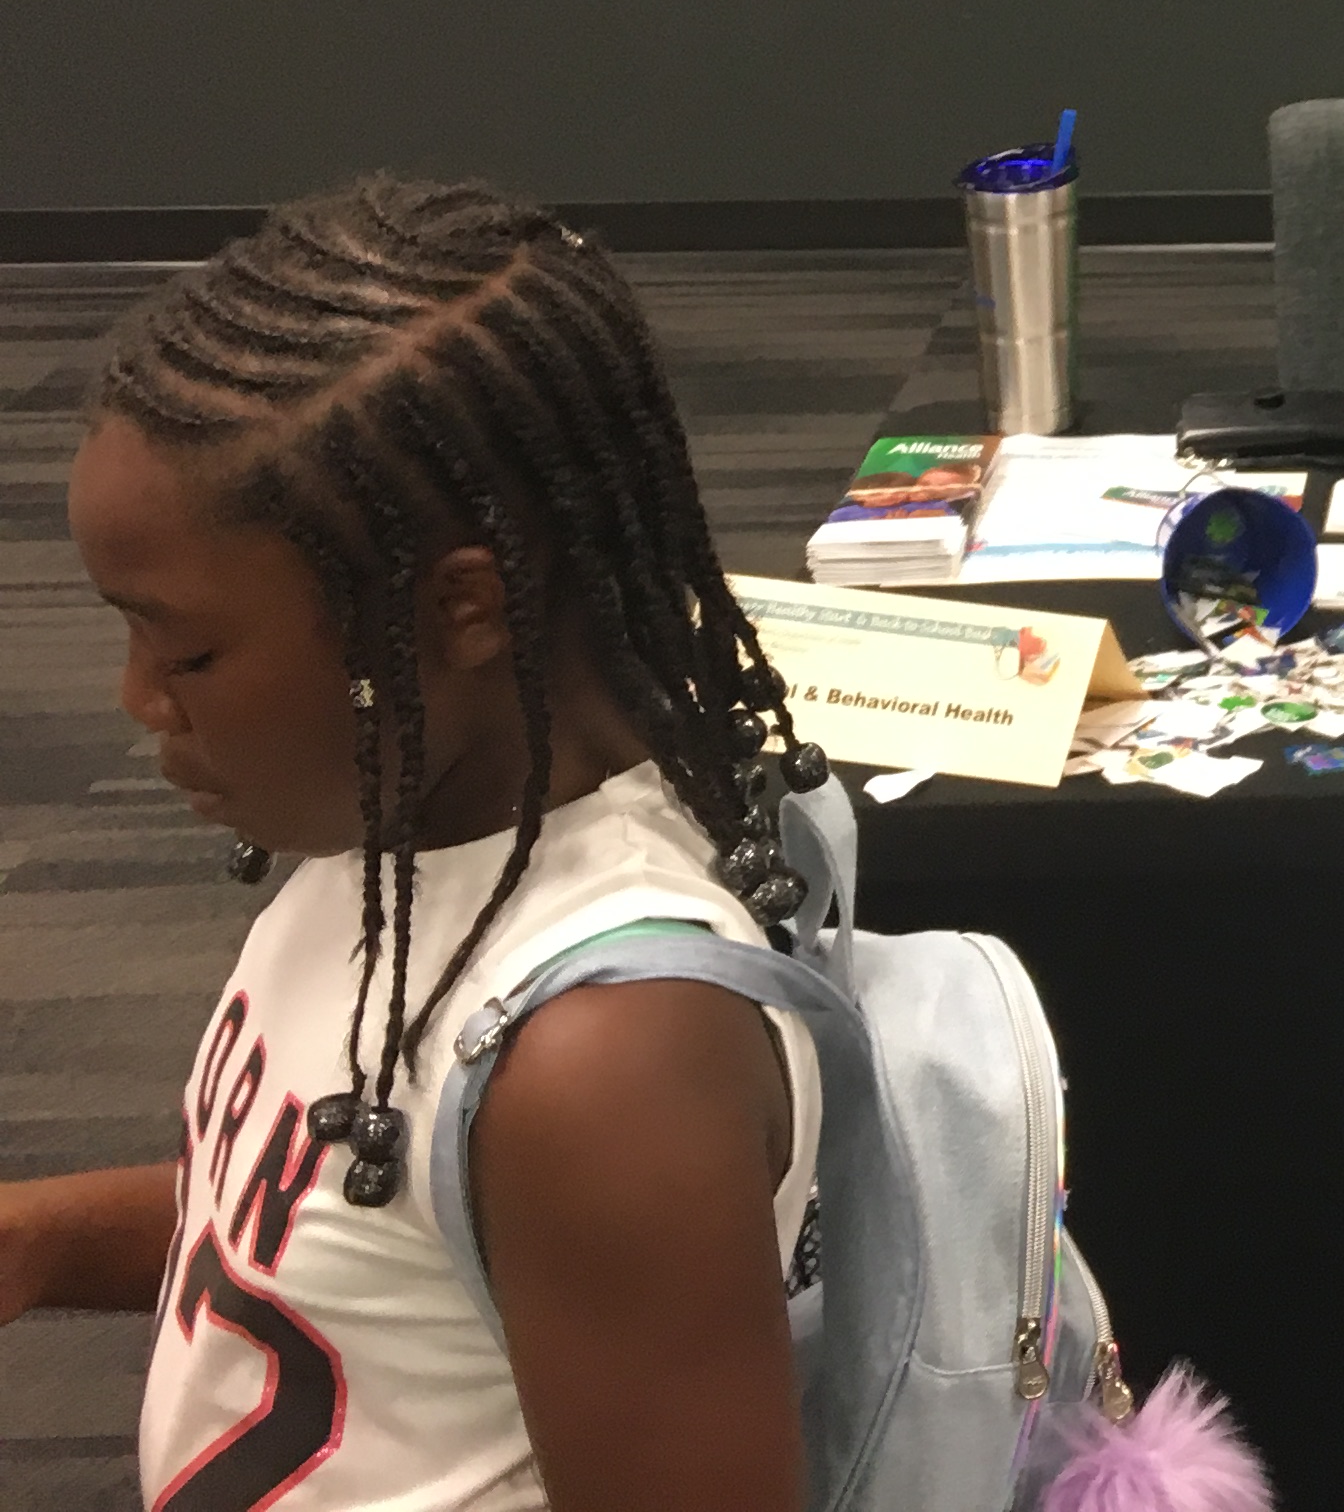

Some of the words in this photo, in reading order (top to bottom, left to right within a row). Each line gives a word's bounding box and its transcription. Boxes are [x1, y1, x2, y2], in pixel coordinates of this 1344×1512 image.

[885, 442, 984, 455] Alliance
[803, 685, 819, 702] &
[826, 688, 940, 717] Behavioral
[944, 702, 1014, 726] Health
